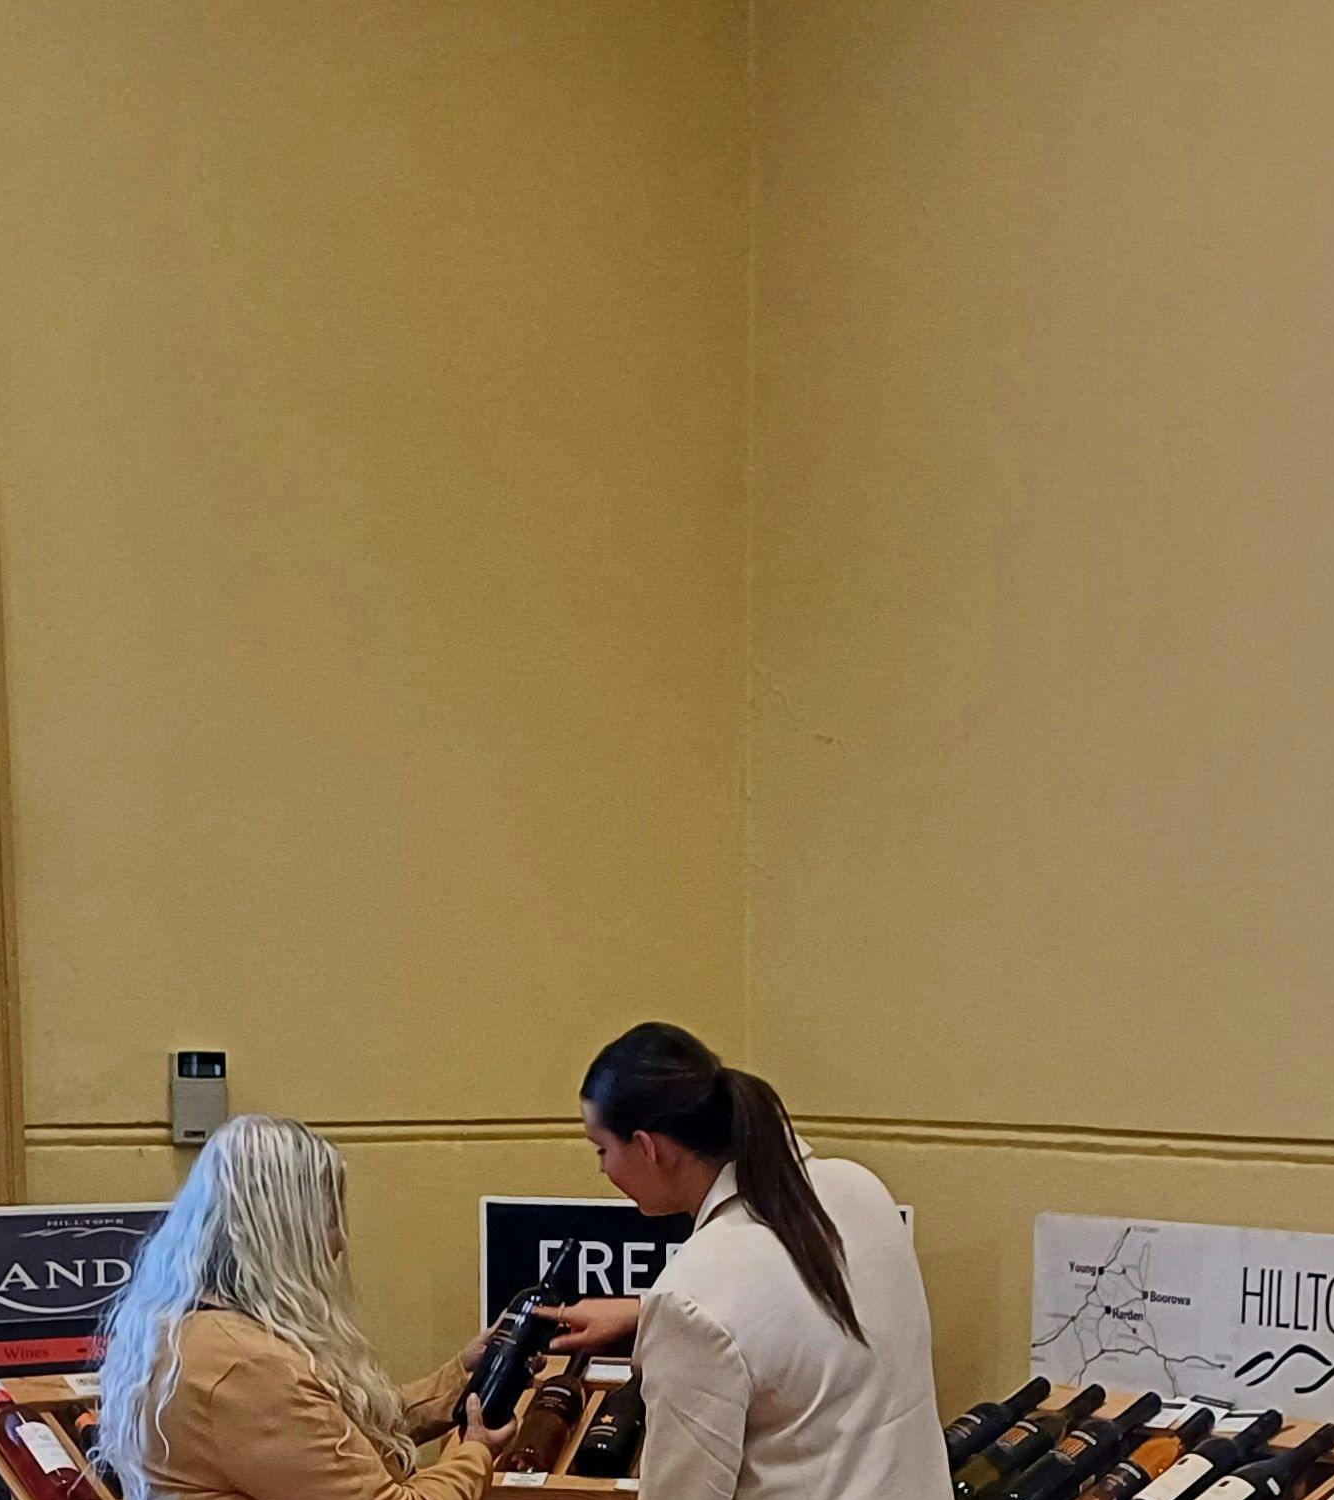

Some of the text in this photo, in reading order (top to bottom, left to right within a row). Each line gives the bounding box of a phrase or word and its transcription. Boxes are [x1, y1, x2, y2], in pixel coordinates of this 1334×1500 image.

[539, 1239, 683, 1295] FRE
[1069, 1261, 1097, 1276] Young
[1150, 1291, 1191, 1306] Boorowa
[1112, 1308, 1144, 1321] Harden
[4, 1347, 49, 1361] Wines
